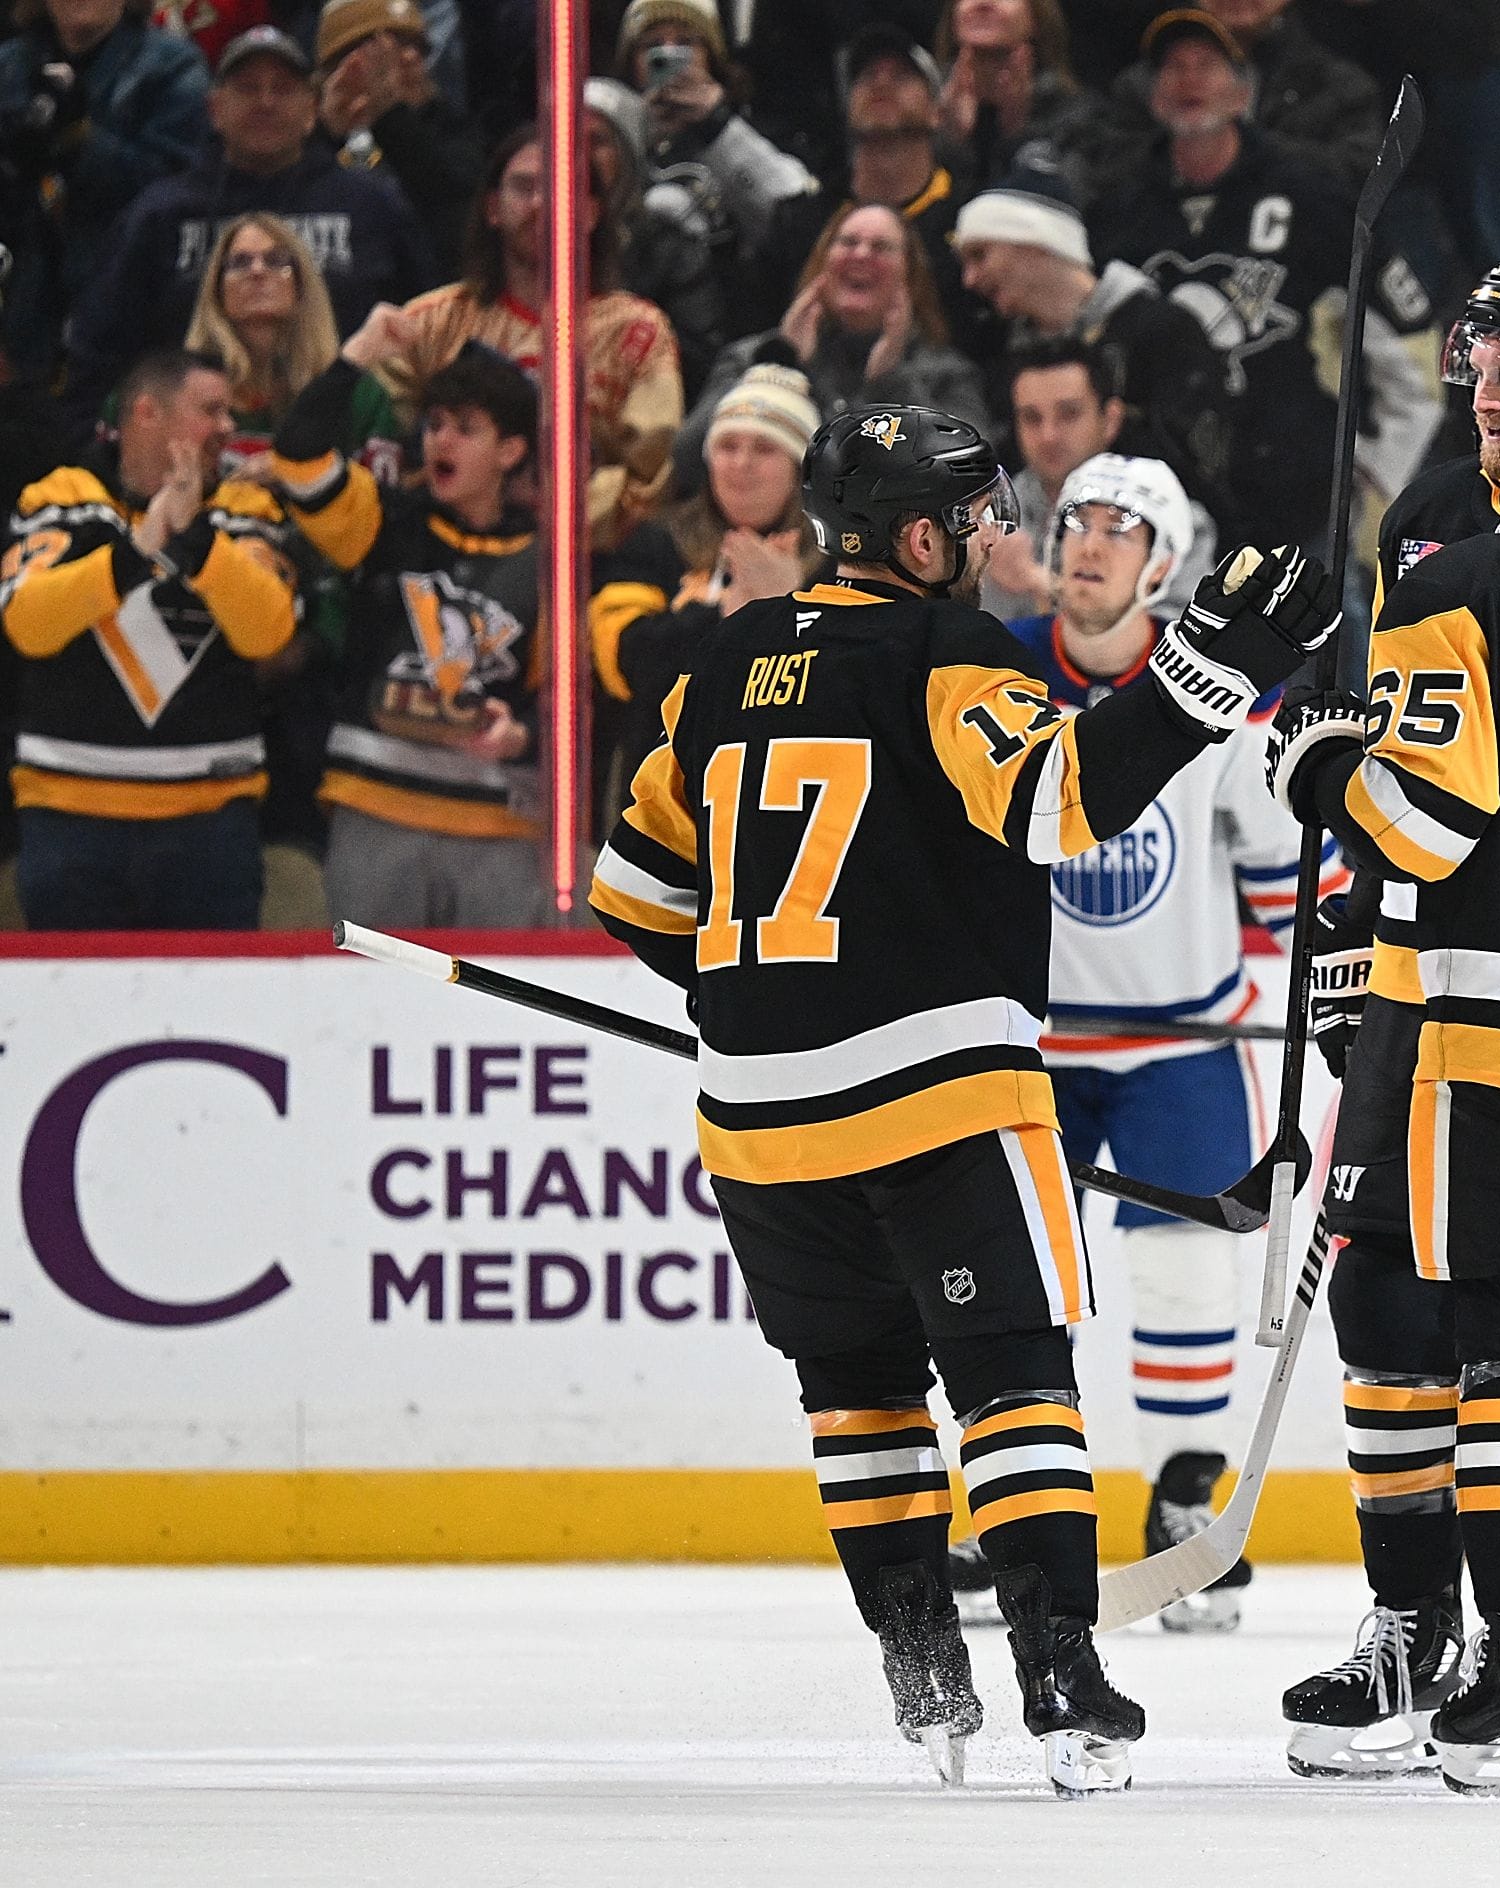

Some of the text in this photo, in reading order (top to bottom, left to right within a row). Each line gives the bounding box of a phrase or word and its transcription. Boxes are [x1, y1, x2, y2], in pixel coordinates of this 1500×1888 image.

[1250, 196, 1292, 252] C
[742, 649, 819, 711] RUST
[1365, 670, 1469, 750] 65
[696, 737, 872, 973] 17
[370, 1046, 590, 1116] LIFE
[370, 1252, 755, 1323] MEDICI
